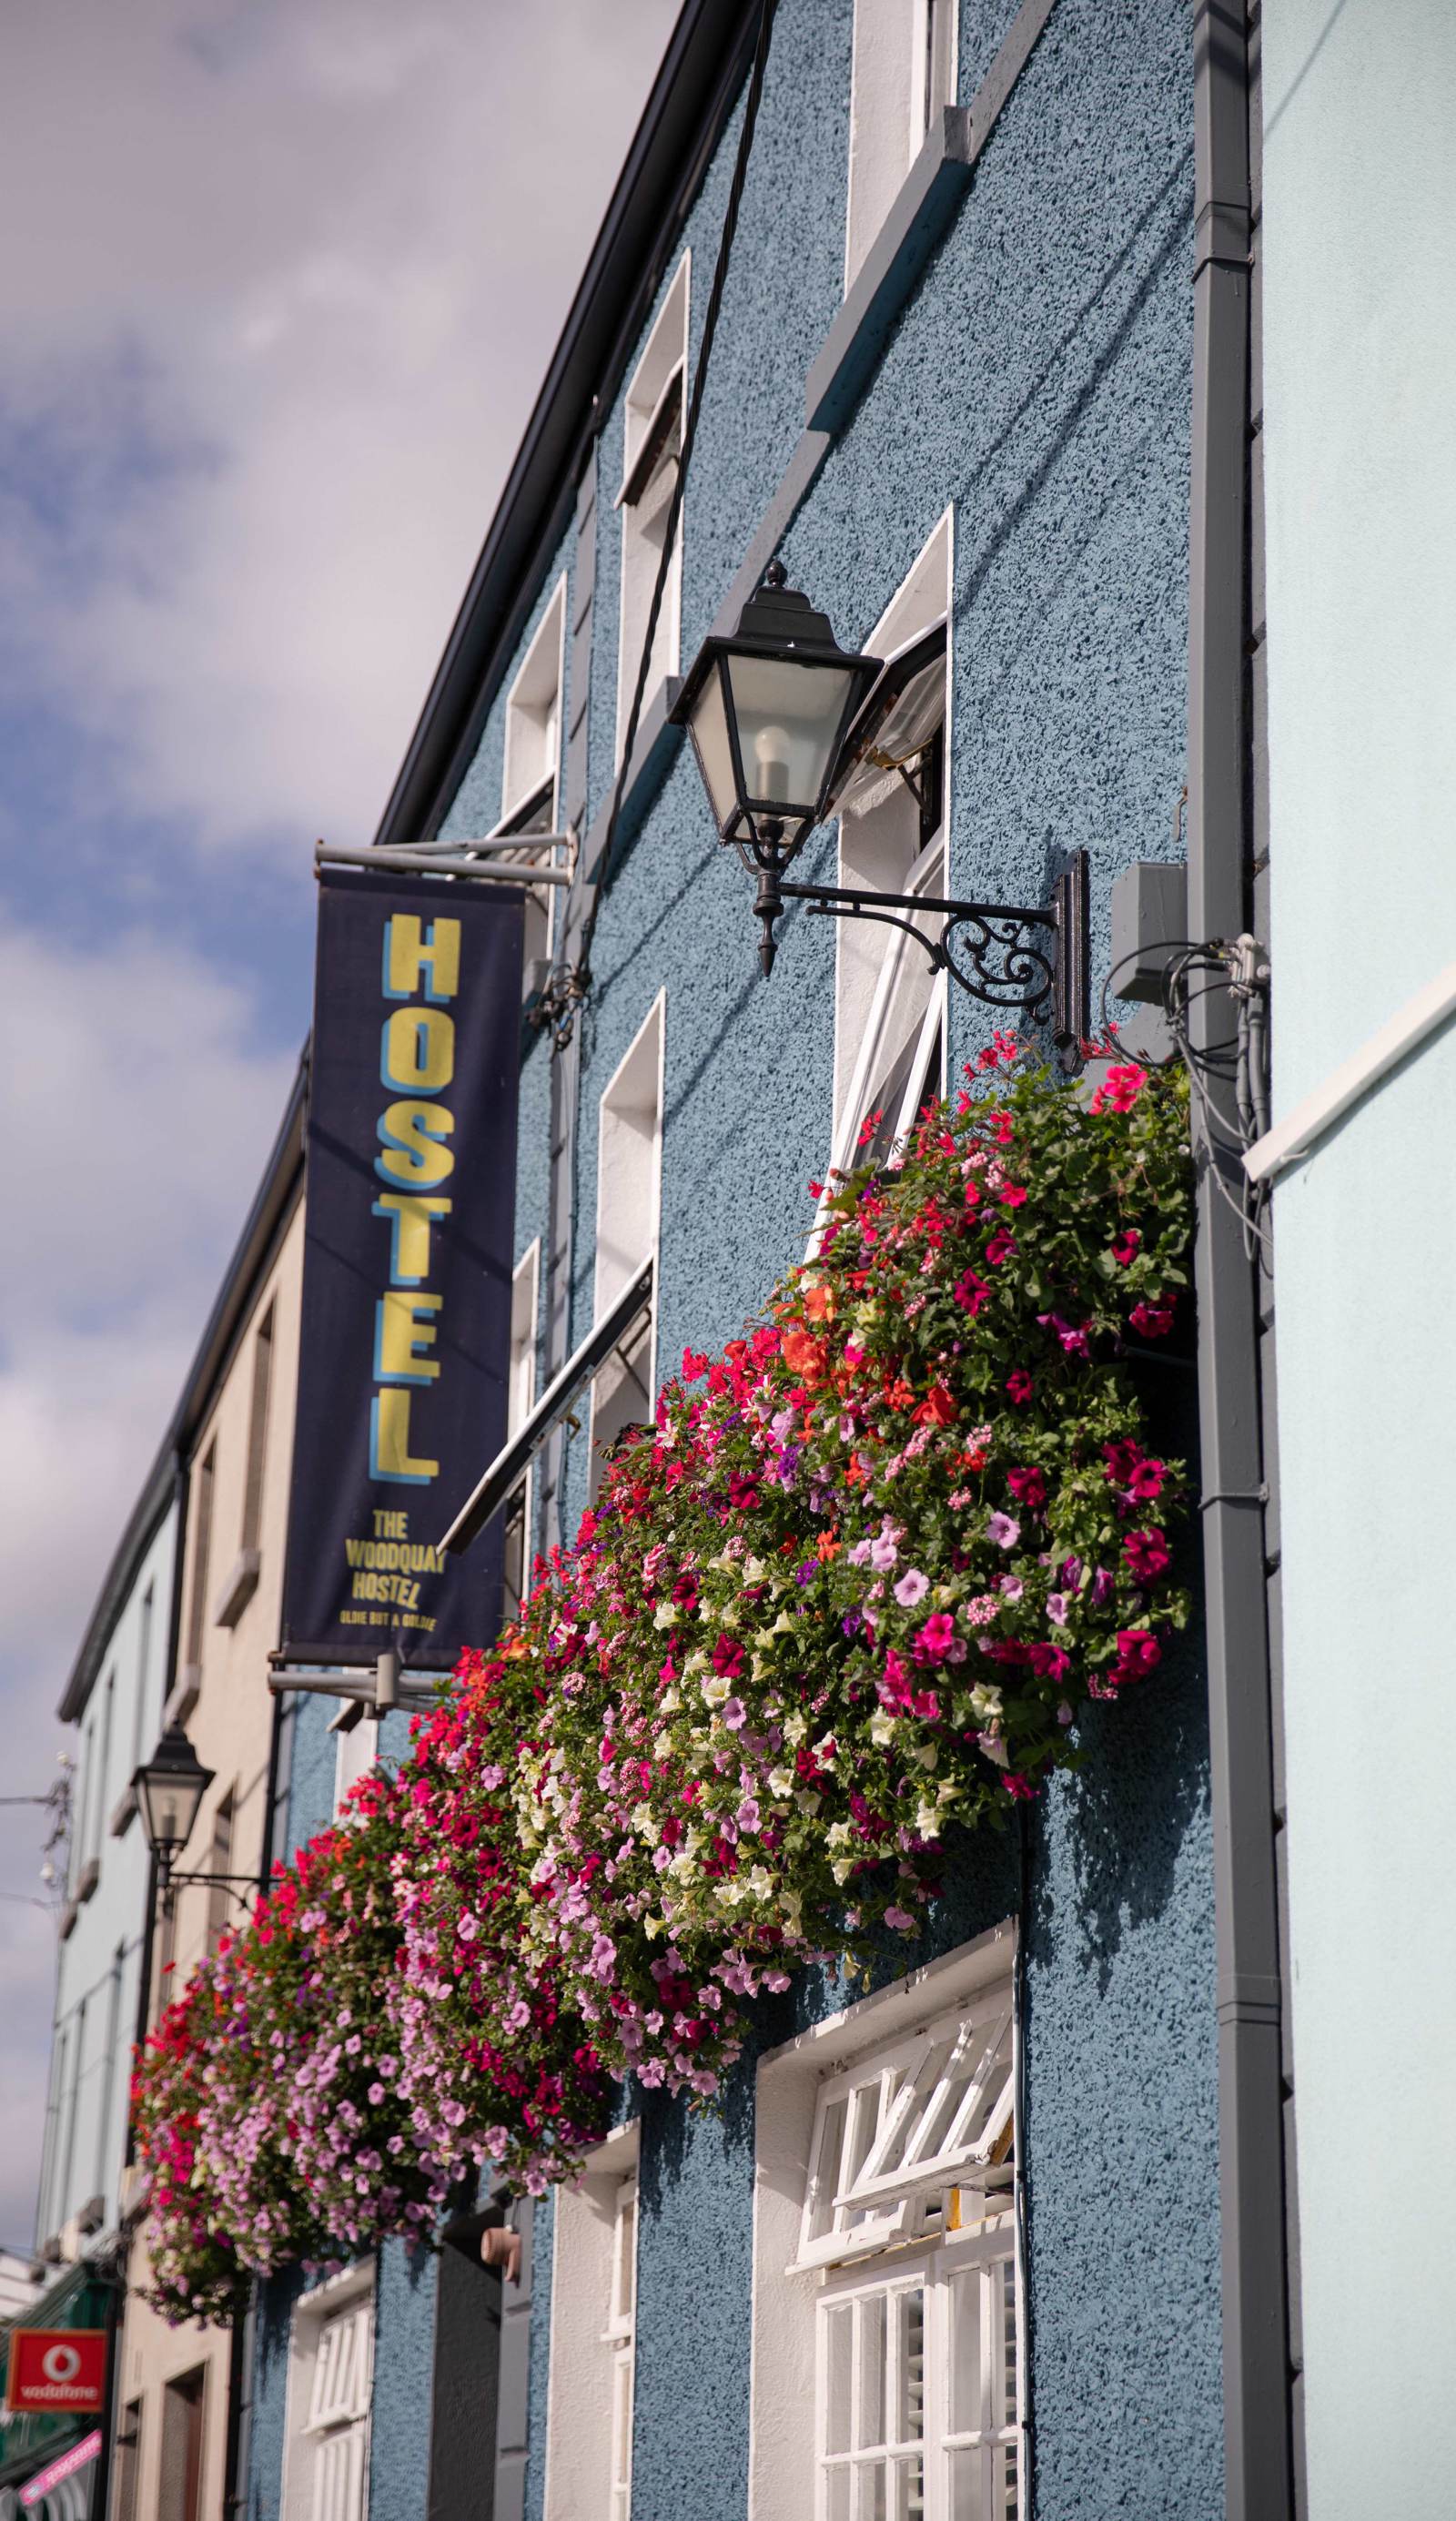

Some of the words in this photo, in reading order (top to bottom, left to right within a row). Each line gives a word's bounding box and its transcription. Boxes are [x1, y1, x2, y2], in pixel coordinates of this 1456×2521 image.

[369, 913, 460, 1484] HOSTEL
[373, 1509, 409, 1539] THE
[345, 1538, 447, 1574] WOODQUAY
[352, 1572, 421, 1610] HOSTEL
[369, 1611, 389, 1626] BUT
[392, 1614, 400, 1626] A
[20, 2382, 97, 2401] vodafone
